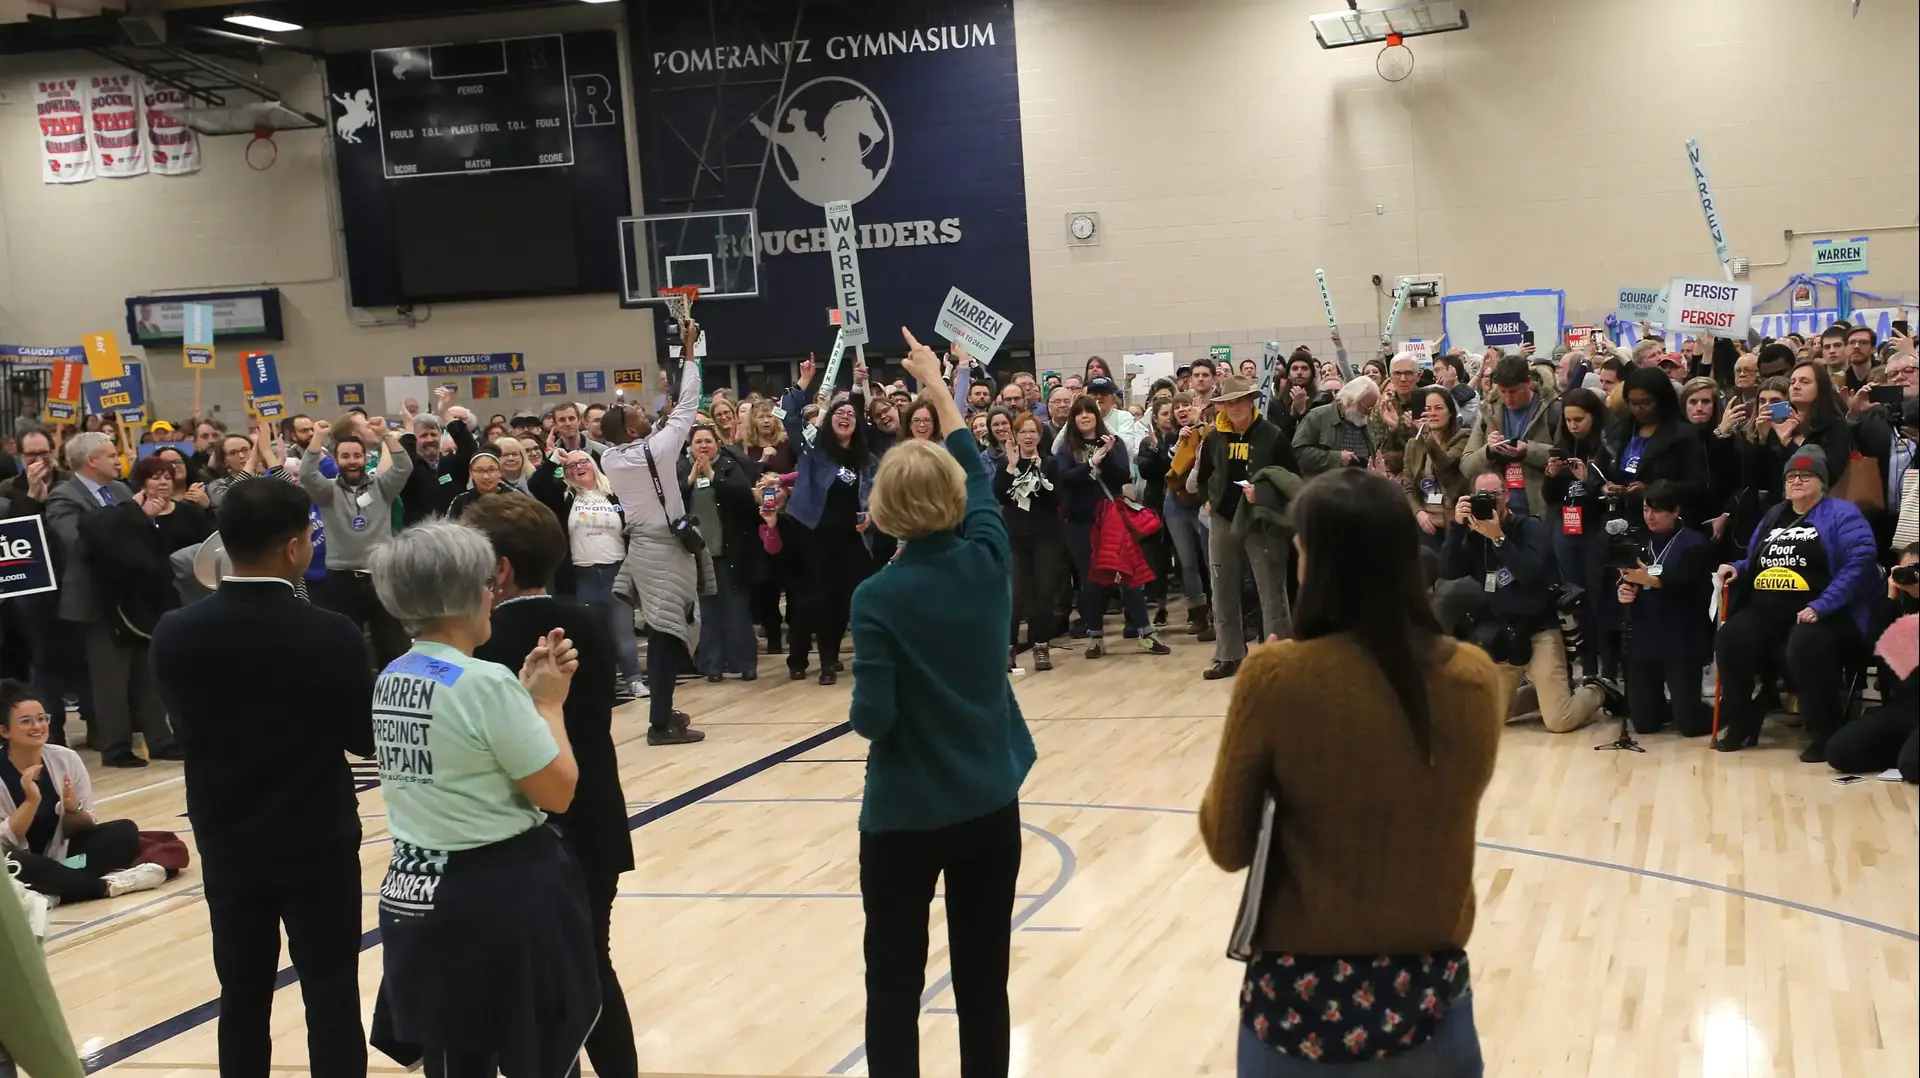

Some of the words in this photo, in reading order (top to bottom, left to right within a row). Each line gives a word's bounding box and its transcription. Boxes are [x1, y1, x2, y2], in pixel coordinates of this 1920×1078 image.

[654, 40, 812, 75] POMERANTZ
[826, 22, 996, 60] GYMNASIUM
[457, 85, 484, 95] PERIOD
[39, 115, 85, 136] STATE
[92, 111, 137, 131] STATE
[390, 130, 414, 139] FOULS
[451, 124, 479, 135] PLAYER
[480, 123, 499, 132] FOUL
[535, 118, 560, 128] FOULS
[464, 159, 491, 169] MATCH
[539, 153, 564, 163] SCORE
[394, 164, 418, 174] SCORE
[1818, 247, 1860, 260] WARREN
[829, 216, 861, 325] WARREN
[1684, 283, 1738, 301] PERSIST
[1317, 277, 1335, 323] WARREN
[951, 294, 1003, 336] WARREN
[1681, 309, 1735, 327] PERSIST
[1485, 323, 1519, 333] WARREN
[942, 320, 953, 330] TEXT
[951, 326, 965, 338] IOWA
[965, 334, 973, 343] TO
[972, 339, 990, 353] 24477
[94, 335, 106, 354] Joy
[1405, 343, 1425, 351] IOWA
[18, 347, 55, 356] CAUCUS
[444, 355, 476, 364] CAUCUS
[476, 354, 491, 362] FOR
[256, 357, 268, 383] Truth
[430, 365, 447, 373] PETE
[489, 363, 507, 371] HERE
[615, 371, 641, 381] PETE
[101, 380, 121, 389] IOWA
[102, 394, 129, 406] PETE
[1769, 544, 1796, 555] Poor
[1760, 555, 1807, 568] People's
[1756, 579, 1798, 589] REVIVAL
[374, 676, 436, 710] WARREN
[373, 719, 430, 746] PRECINCT
